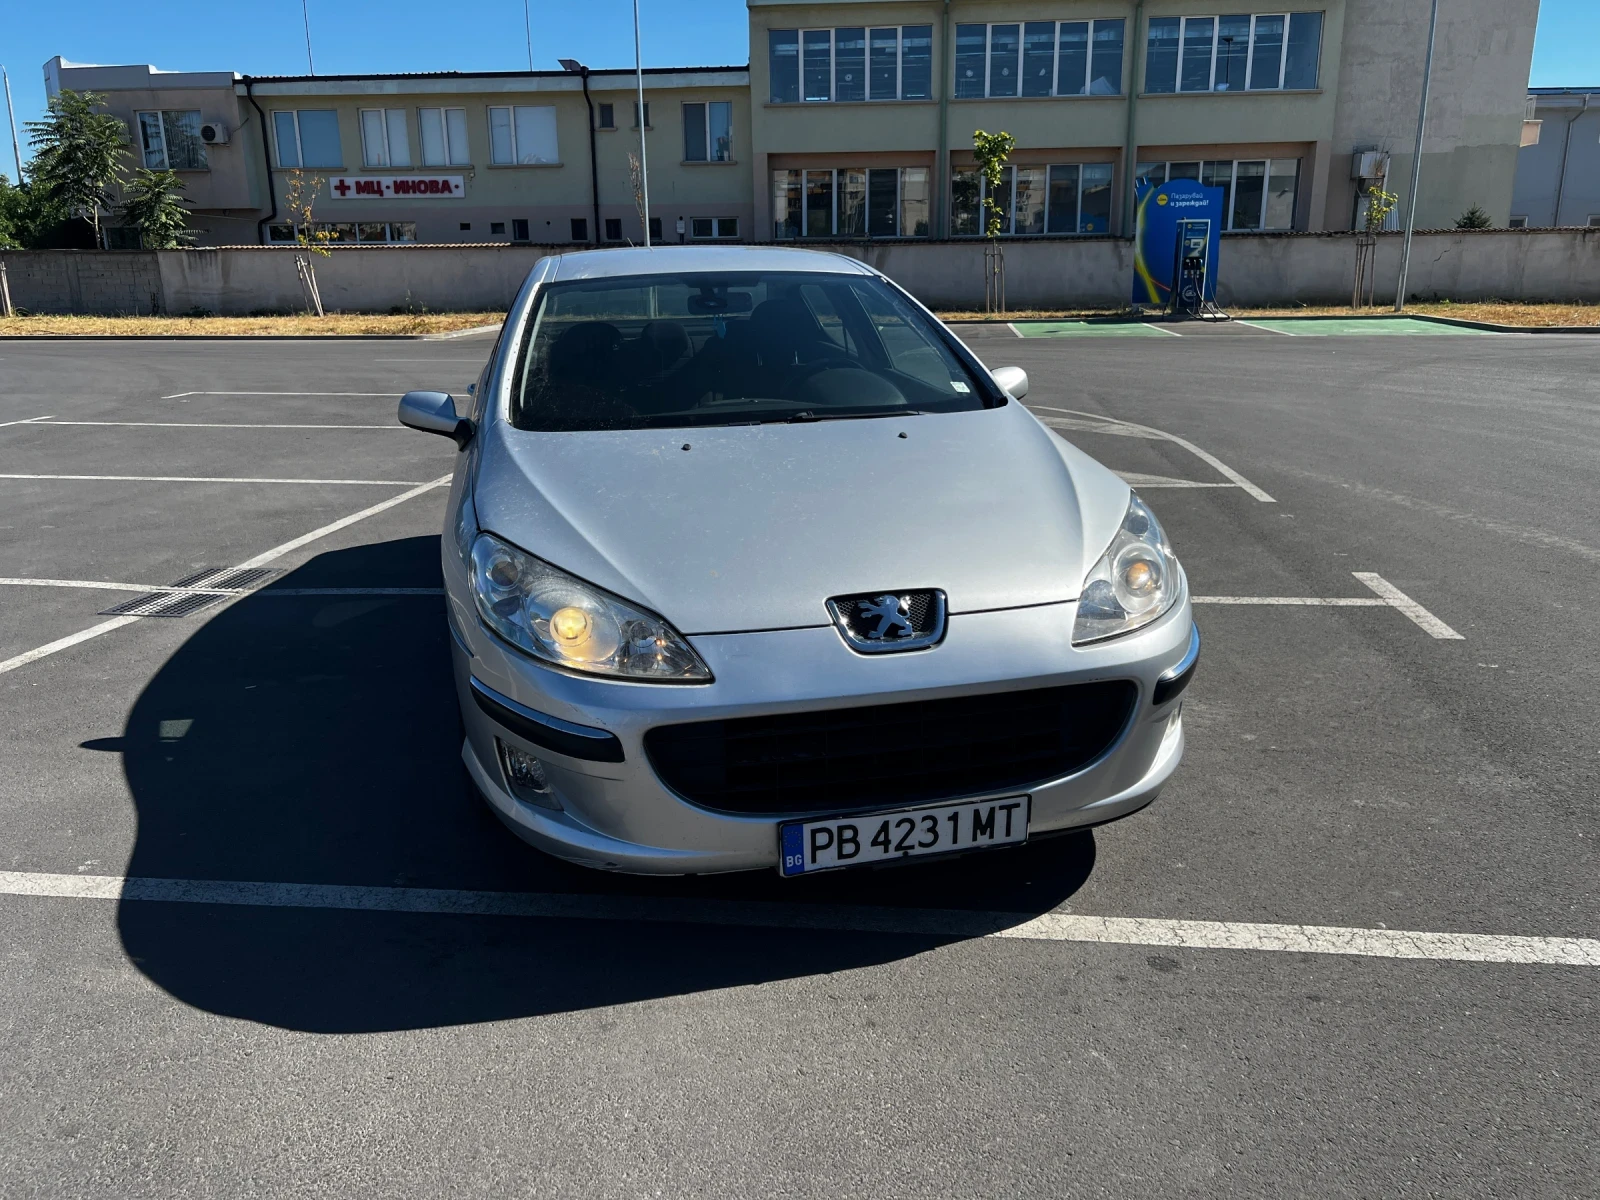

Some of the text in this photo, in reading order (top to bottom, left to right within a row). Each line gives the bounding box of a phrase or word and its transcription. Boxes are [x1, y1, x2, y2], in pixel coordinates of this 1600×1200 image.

[355, 180, 453, 197] МЦ ИНОВА
[1171, 192, 1204, 200] Пазарувай
[810, 803, 1021, 864] PB 4231 MT
[786, 854, 803, 868] BG
